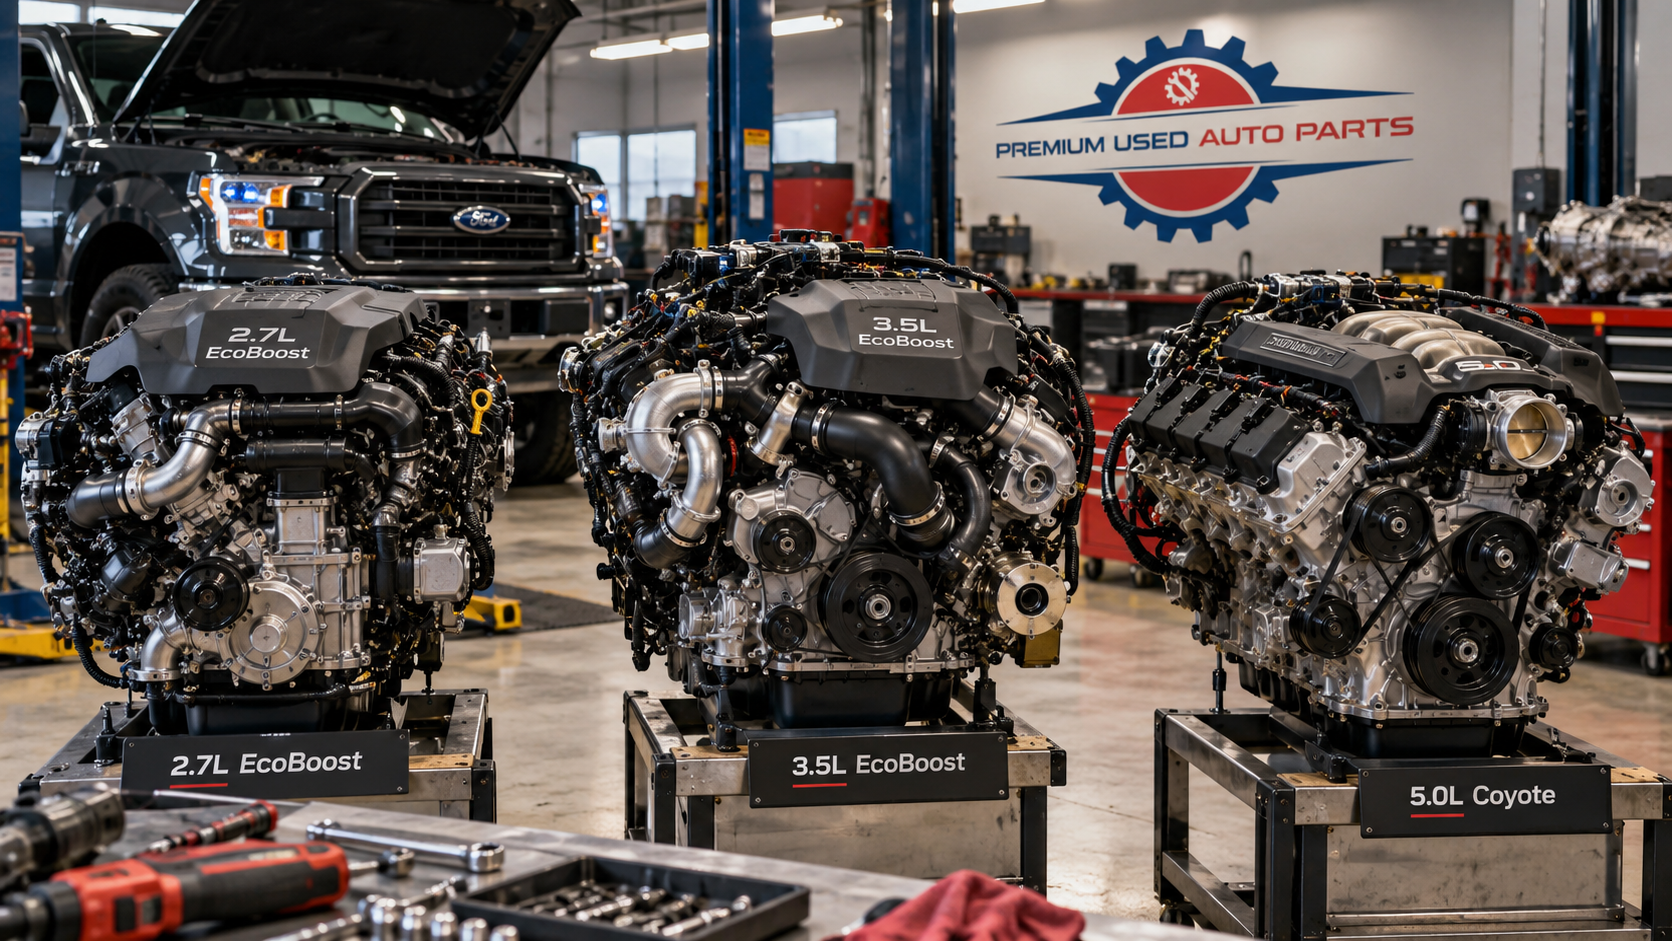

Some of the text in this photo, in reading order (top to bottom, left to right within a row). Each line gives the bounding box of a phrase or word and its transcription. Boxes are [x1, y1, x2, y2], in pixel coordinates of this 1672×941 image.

[996, 116, 1415, 159] PREMIUM USED AUTO PARTS
[873, 316, 937, 333] 3.5L
[228, 327, 296, 343] 2.7L
[858, 333, 955, 349] EcoBoost
[205, 346, 311, 360] EcoBoost
[170, 751, 363, 777] 2.7L EcoBoost
[792, 753, 966, 776] 3.5L EcoBoost
[1410, 785, 1556, 810] 5.0L Coyote
